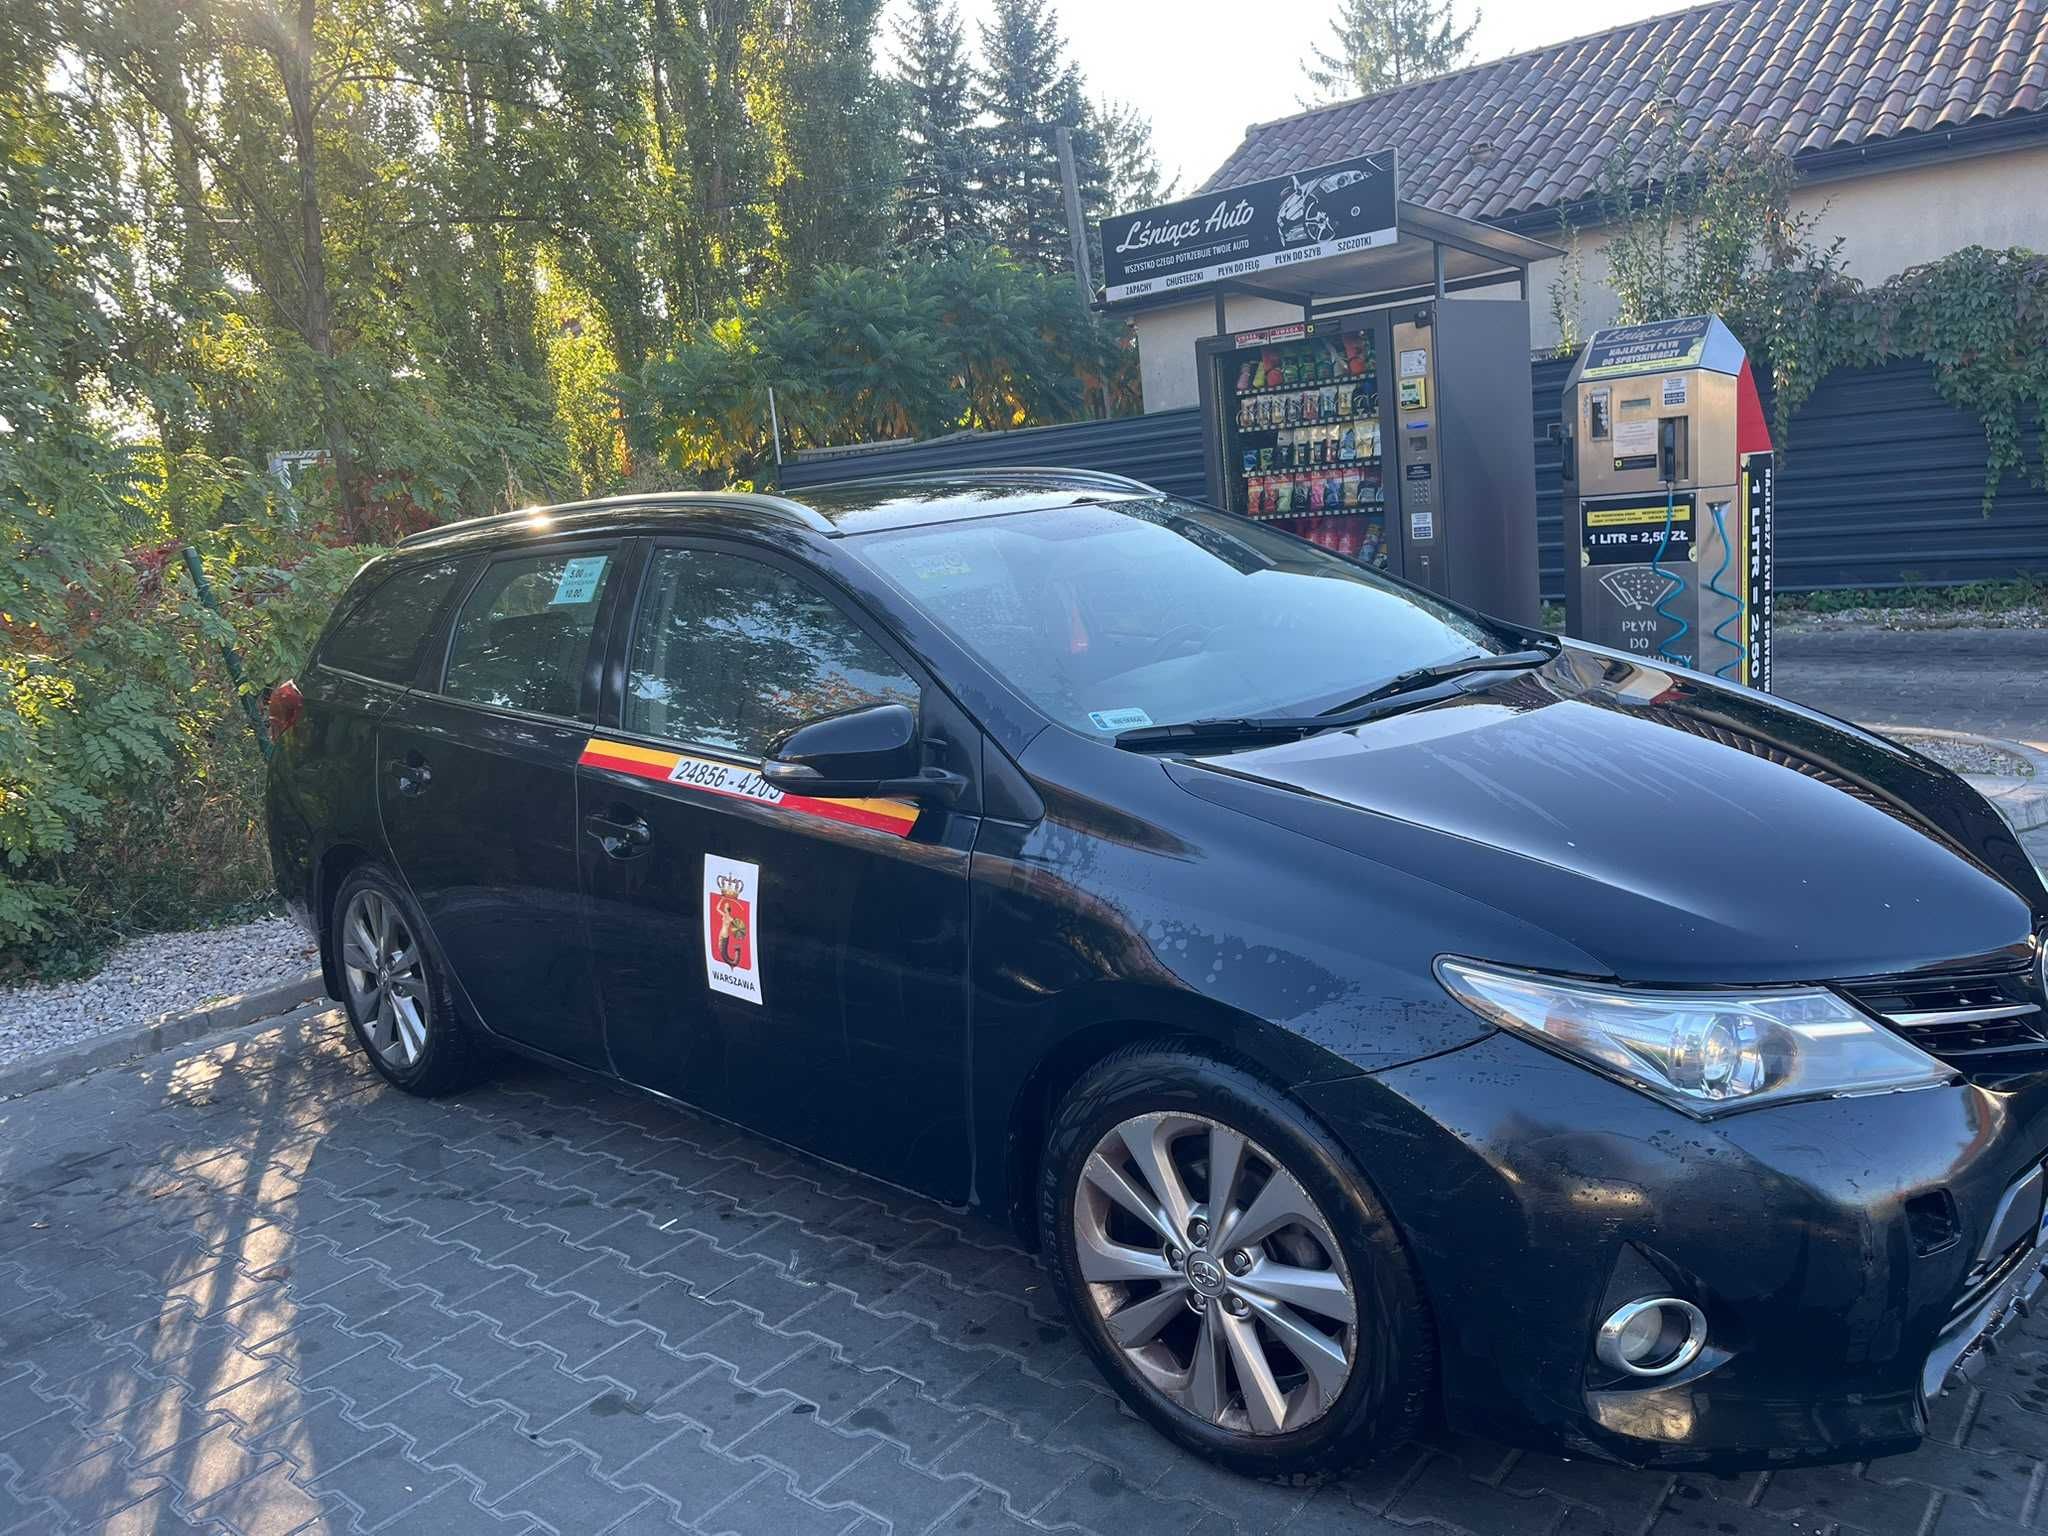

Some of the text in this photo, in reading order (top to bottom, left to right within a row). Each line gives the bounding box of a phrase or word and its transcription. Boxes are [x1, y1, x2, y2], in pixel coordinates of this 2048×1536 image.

[1116, 199, 1254, 253] Lśniące Auto
[1337, 236, 1372, 252] SZCZOTKI
[1124, 239, 1249, 275] WSZYSTKO CZEGO POTRZEBUJE TWOJE AUTO
[1275, 247, 1321, 265] PŁYN DO SZYB
[1218, 259, 1260, 277] PŁYN DO FELG
[1166, 271, 1204, 287] CHUSTECZKI
[1125, 283, 1152, 295] ZAPACHY
[1665, 320, 1704, 336] Auto
[1609, 340, 1680, 357] NAJLEPSZY PŁYN
[1615, 349, 1680, 365] SPRYSKIWACZY
[1752, 480, 1760, 494] 1
[1589, 534, 1596, 544] 1
[1599, 533, 1627, 544] LITR
[1670, 530, 1689, 541] ZŁ
[1751, 507, 1760, 579] LITR
[1764, 595, 1771, 615] DO
[1622, 620, 1657, 632] PŁYN
[1630, 638, 1649, 648] DO
[1750, 613, 1760, 679] 2,50
[675, 761, 728, 787] 24856
[711, 970, 756, 991] WARSZAWA
